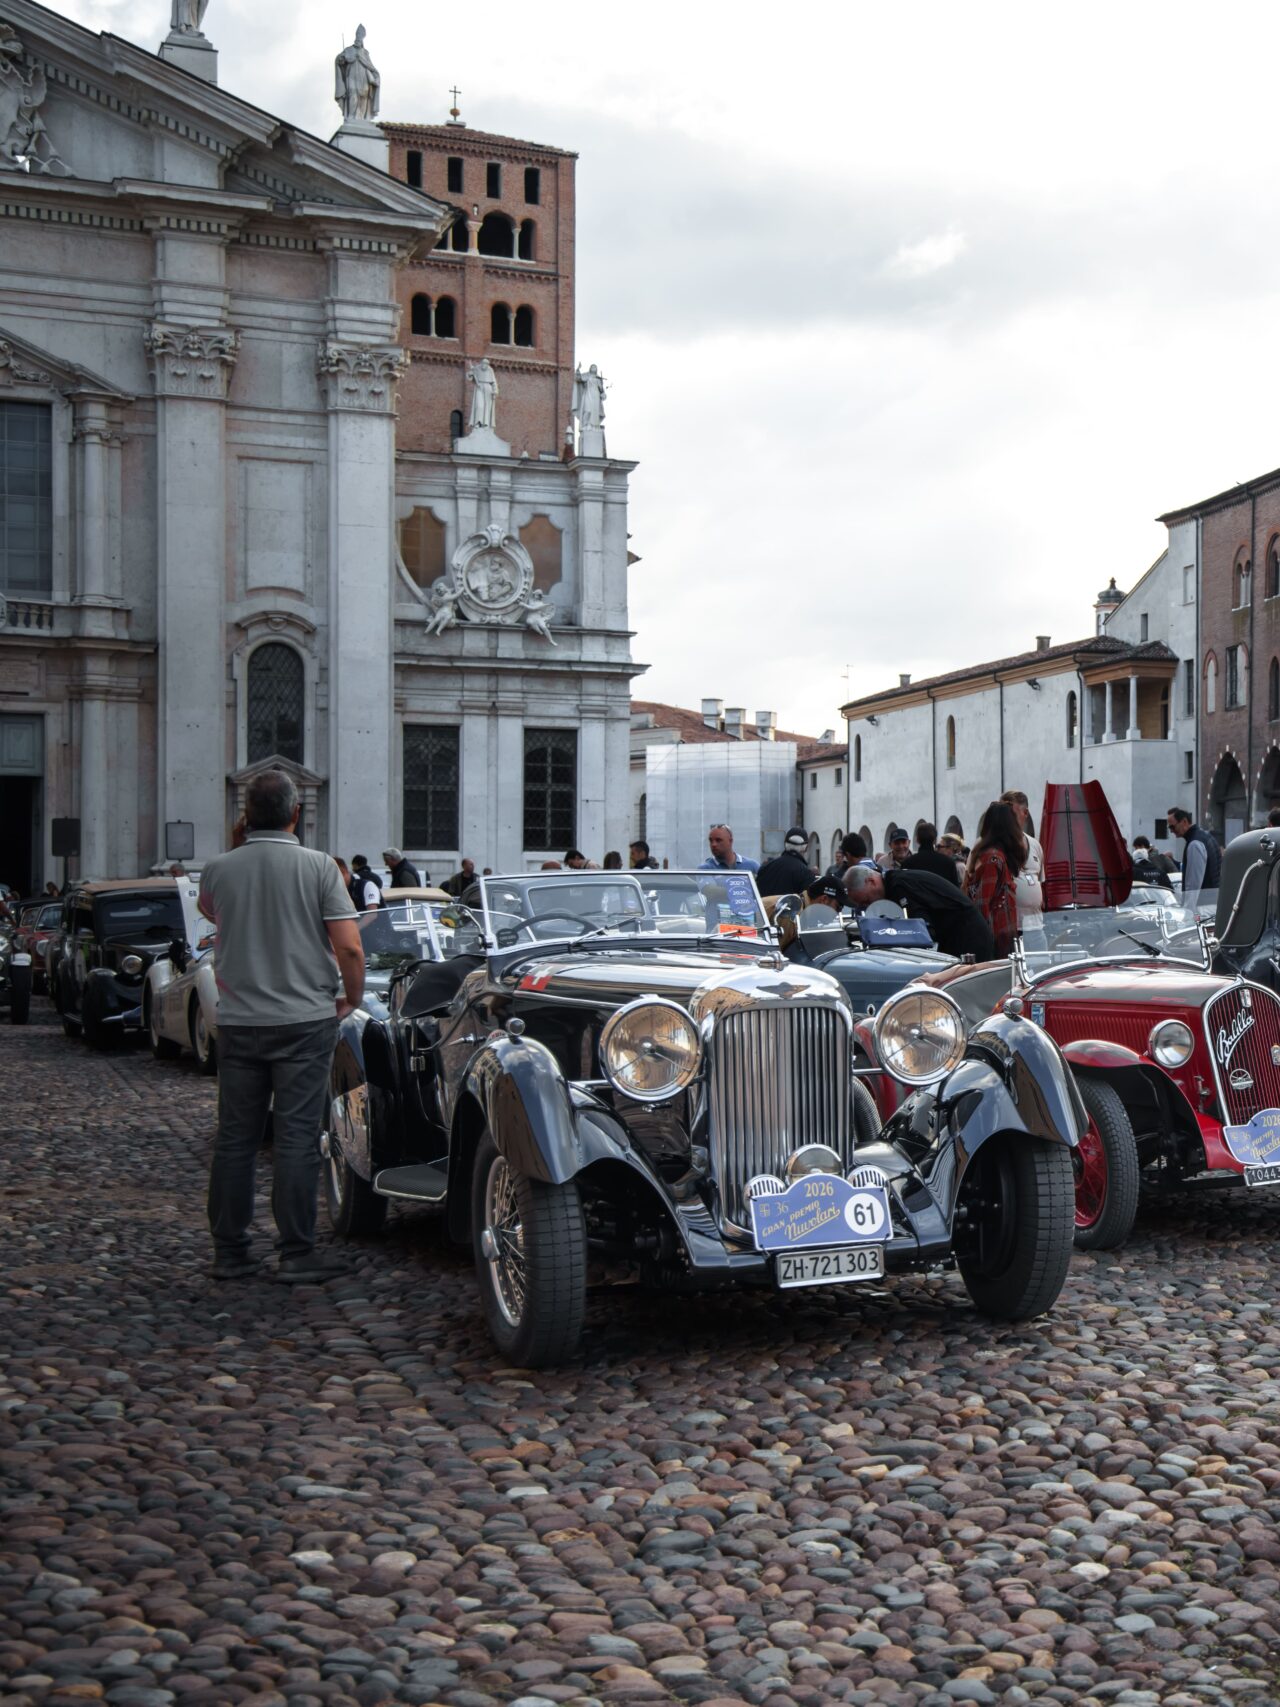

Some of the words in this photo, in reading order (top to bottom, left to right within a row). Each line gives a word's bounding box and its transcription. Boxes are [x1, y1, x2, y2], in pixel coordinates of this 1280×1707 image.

[1216, 1008, 1254, 1070] Balilla
[804, 1181, 834, 1198] 2026
[762, 1219, 785, 1238] GRAN
[790, 1200, 820, 1220] PREMIO
[777, 1202, 789, 1217] 36
[784, 1202, 840, 1242] Nuvolari
[853, 1202, 876, 1226] 61
